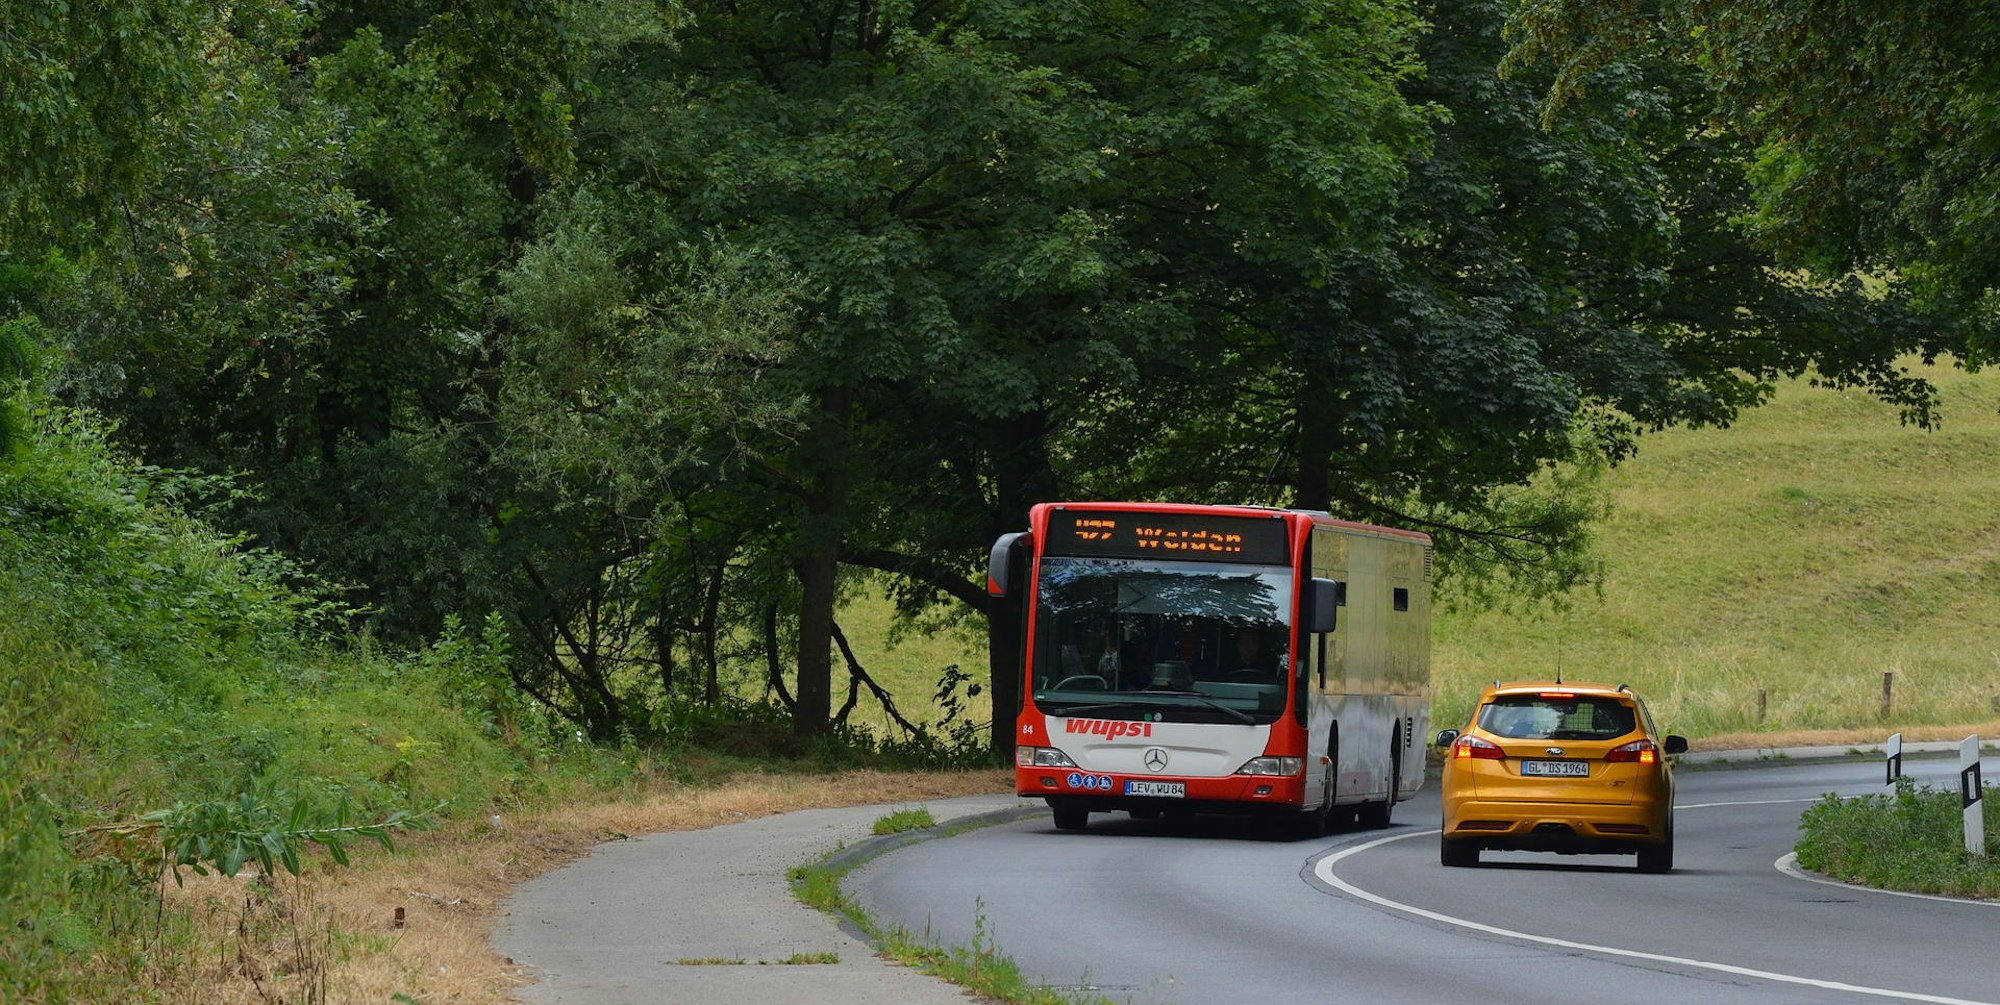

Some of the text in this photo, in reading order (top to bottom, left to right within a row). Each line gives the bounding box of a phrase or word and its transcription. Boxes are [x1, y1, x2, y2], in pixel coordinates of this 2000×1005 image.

[1022, 724, 1034, 735] 84
[1066, 719, 1152, 741] wupsi
[1528, 762, 1541, 773] GL
[1131, 783, 1151, 793] LEV
